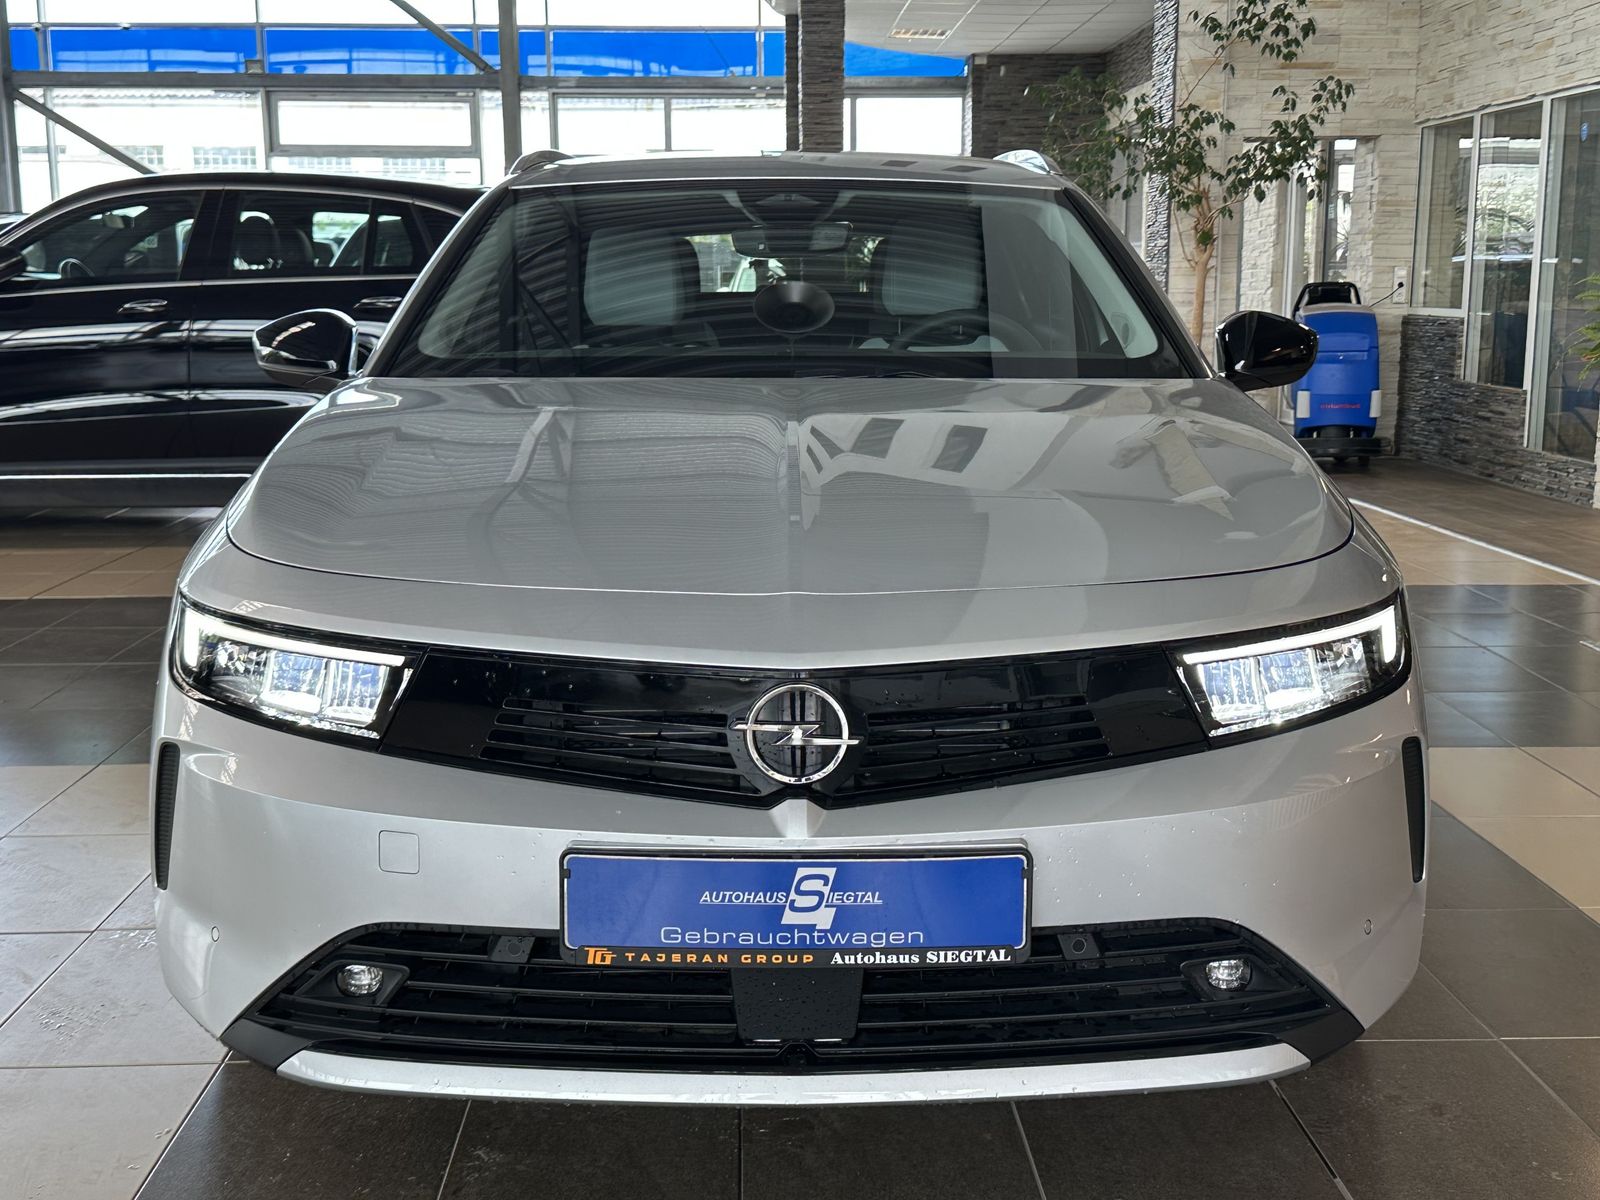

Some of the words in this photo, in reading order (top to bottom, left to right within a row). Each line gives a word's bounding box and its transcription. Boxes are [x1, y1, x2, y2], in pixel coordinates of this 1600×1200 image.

[700, 891, 787, 903] AUTOHAUS
[660, 926, 924, 947] Gebrauchtwagen
[625, 952, 728, 963] TAJERAN
[740, 954, 814, 964] GROUP
[830, 951, 920, 965] Autohaus
[926, 949, 1011, 964] SIEGTAL
